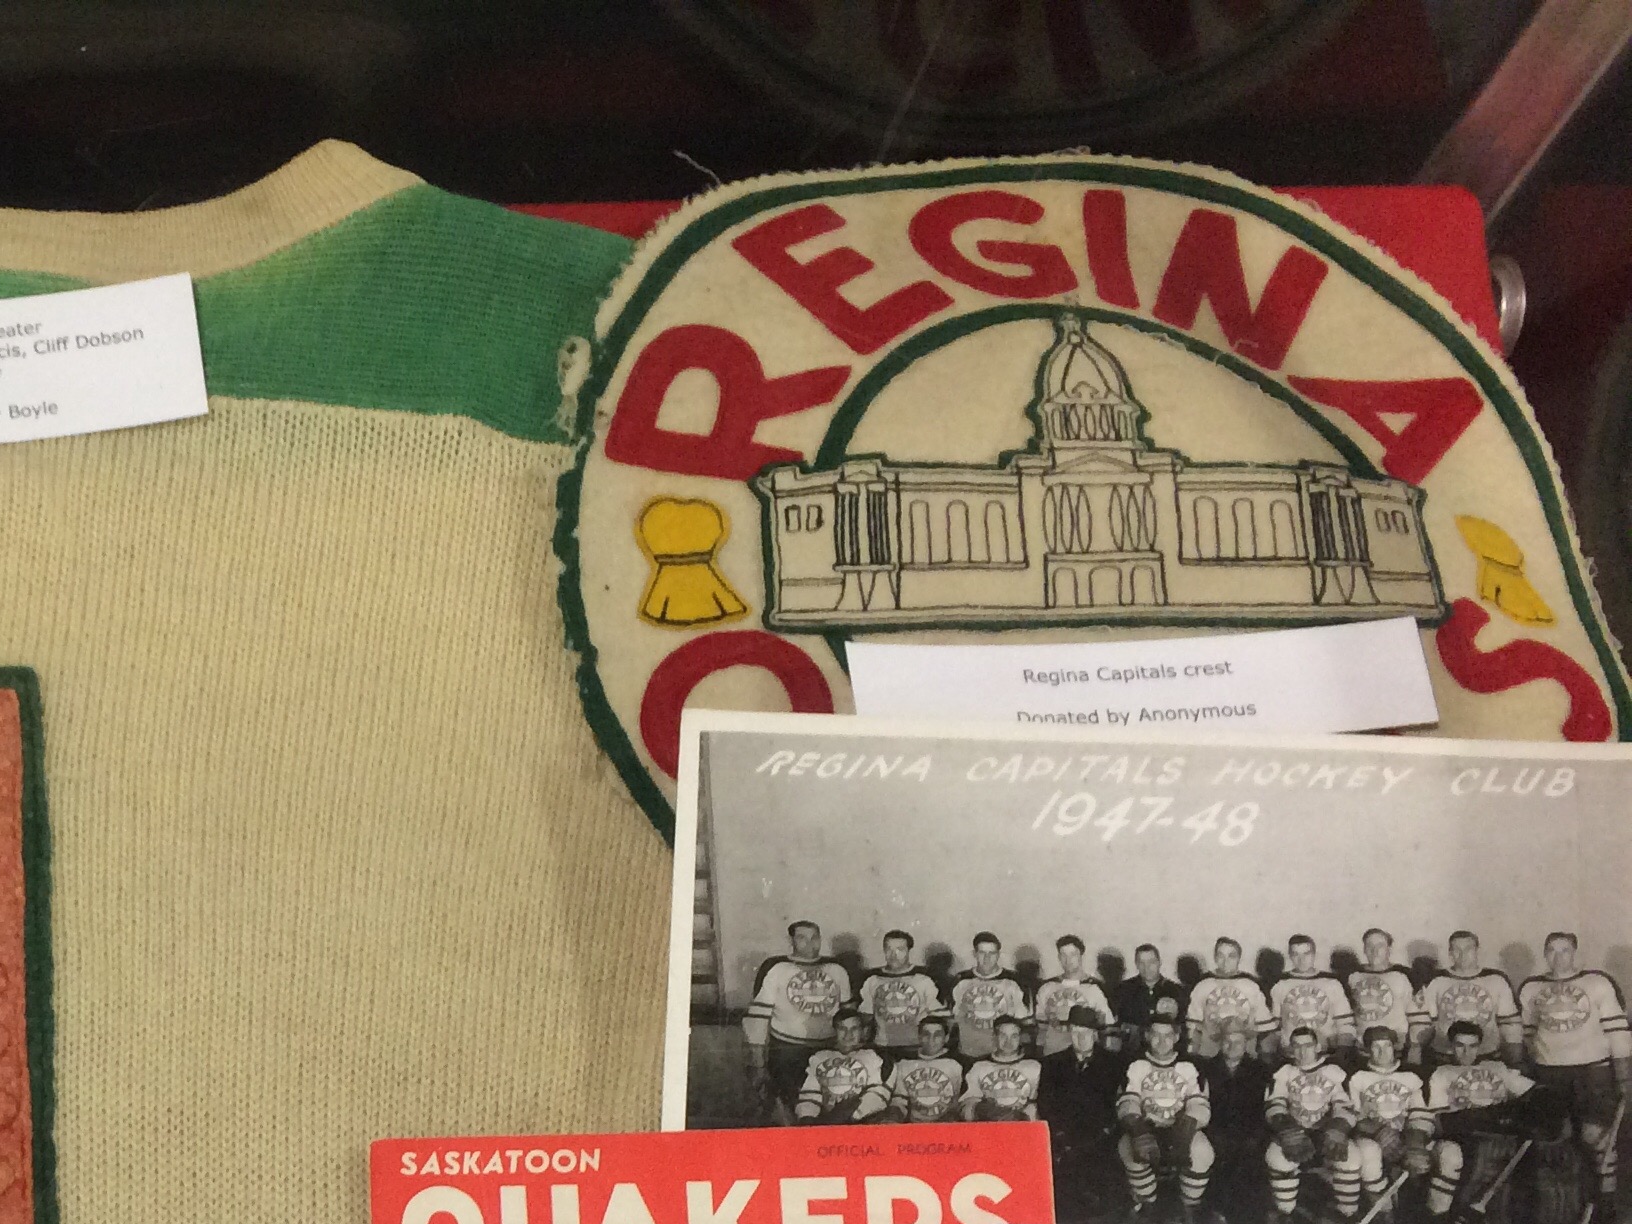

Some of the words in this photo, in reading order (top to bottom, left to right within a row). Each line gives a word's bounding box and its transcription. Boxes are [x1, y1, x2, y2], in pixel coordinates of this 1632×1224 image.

[33, 335, 70, 356] Cliff
[75, 326, 145, 352] Dobson
[604, 189, 1484, 486] REGINA
[8, 398, 59, 420] Boyle
[1022, 667, 1090, 687] Regina
[1096, 663, 1178, 684] Capitals
[1183, 660, 1233, 678] crest
[1106, 708, 1130, 727] by
[1138, 702, 1258, 724] Anonymous
[755, 749, 933, 783] REGINA
[966, 753, 1184, 786] CAPITALS
[1211, 757, 1414, 796] HOCKEY
[1449, 766, 1577, 798] CLUB
[1031, 789, 1261, 847] 1947-48
[399, 1148, 602, 1176] SASKATOON
[816, 1143, 884, 1159] OFFICIAL
[897, 1142, 973, 1157] PROGRAM
